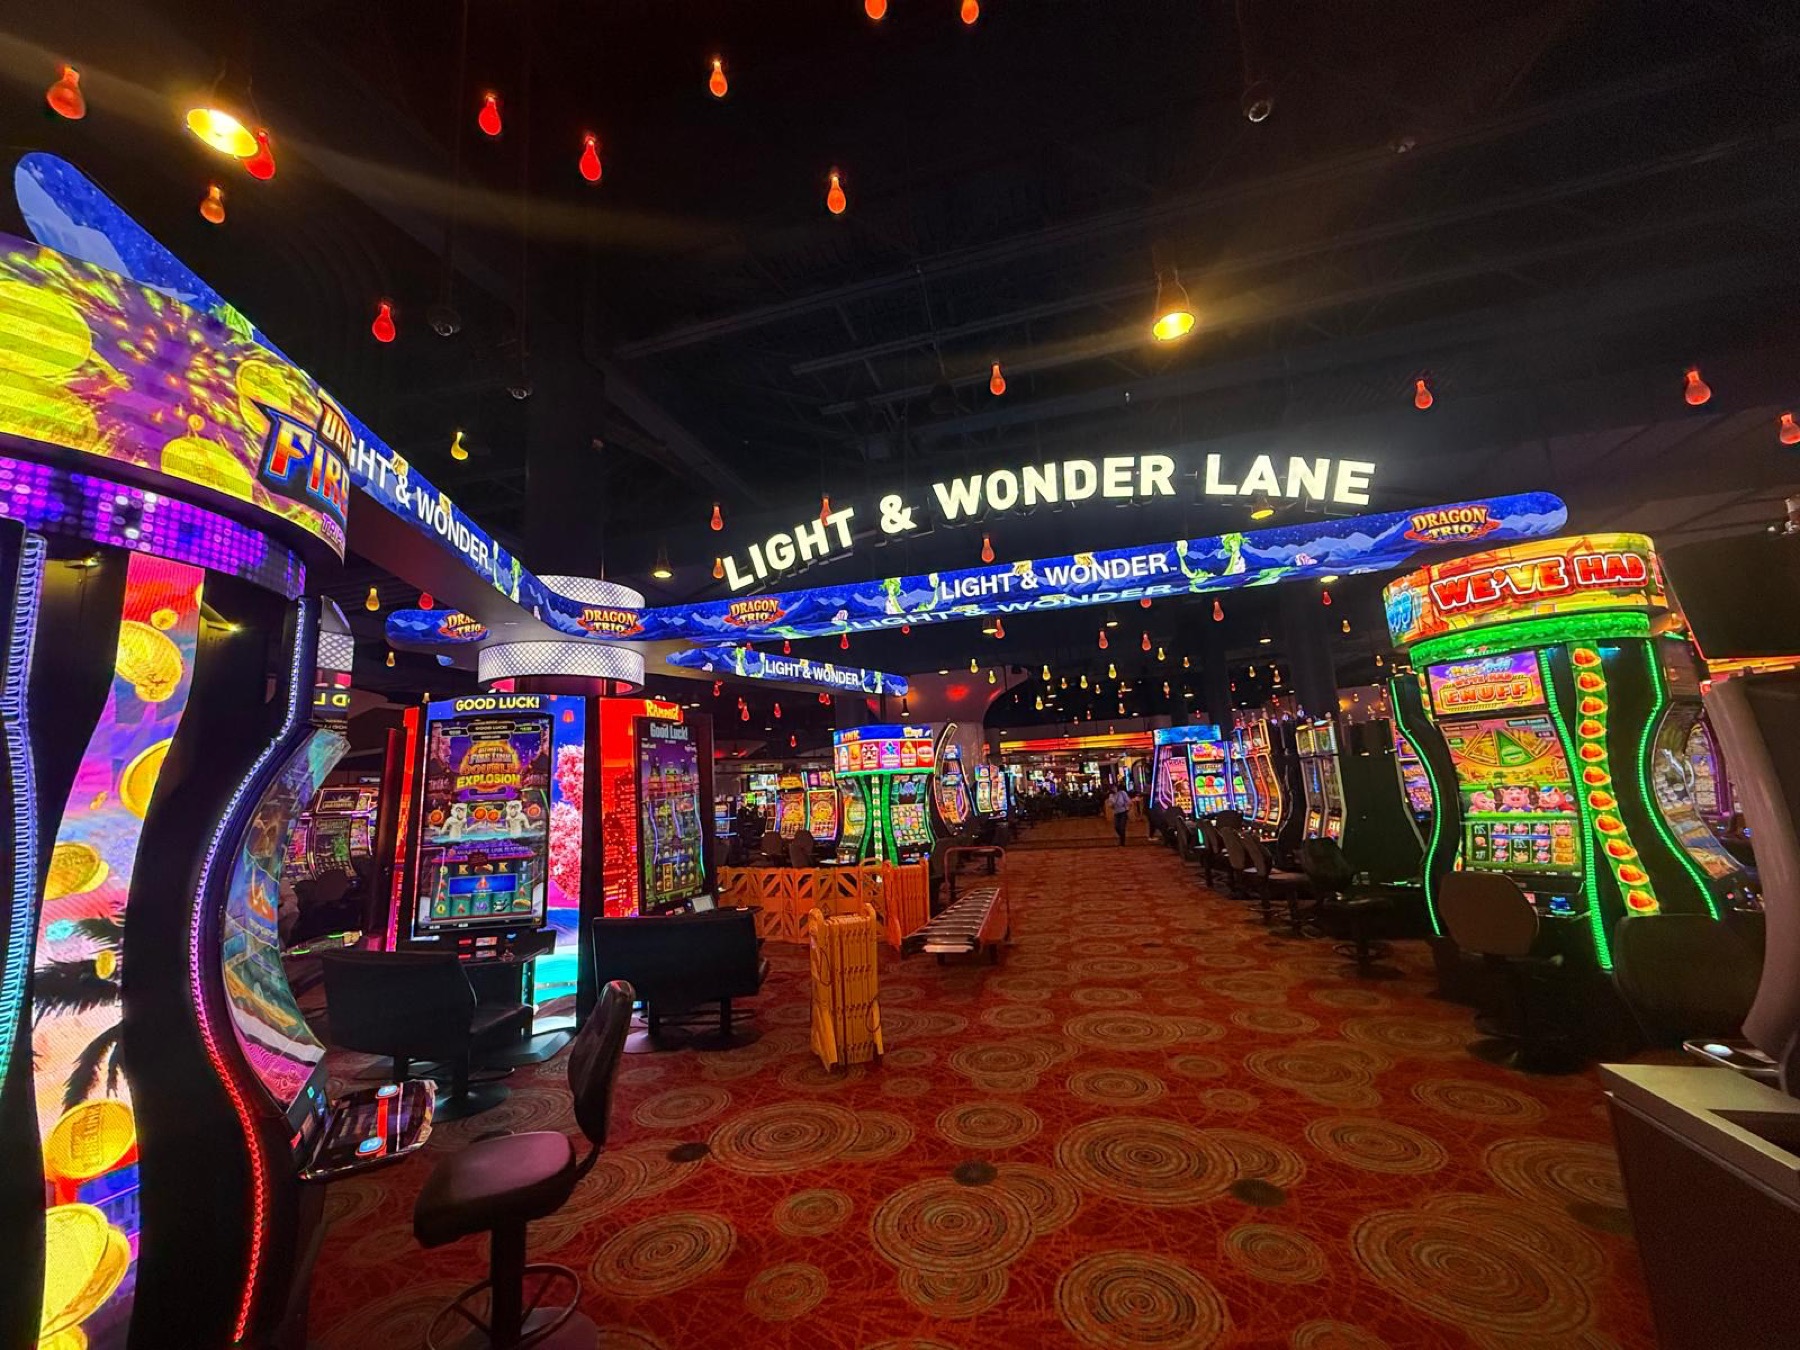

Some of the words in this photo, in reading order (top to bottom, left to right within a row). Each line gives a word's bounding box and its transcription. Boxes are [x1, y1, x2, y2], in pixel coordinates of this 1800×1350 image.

[395, 474, 411, 510] &
[723, 507, 854, 592] LIGHT
[879, 494, 918, 534] &
[932, 454, 1176, 521] WONDER
[1205, 453, 1377, 506] LANE
[1411, 507, 1487, 532] DRAGON
[1427, 524, 1474, 539] TRIO
[940, 573, 1016, 601] LIGHT
[1020, 571, 1039, 590] &
[1431, 556, 1569, 611] WE'VE
[1574, 553, 1647, 585] HAD
[730, 599, 779, 617] DRAGON
[447, 613, 477, 629] DRA
[583, 609, 638, 627] DRAGON
[739, 612, 769, 623] TRIO
[457, 624, 481, 635] TRIO
[593, 622, 625, 632] TRIO
[765, 659, 801, 678] LIGHT
[802, 666, 812, 679] &
[1446, 682, 1527, 705] ENUFF
[455, 698, 496, 711] GOOD
[498, 696, 540, 709] LUCK!
[649, 722, 669, 738] Good
[669, 724, 689, 740] Luck!
[456, 773, 520, 789] EXPLOSION
